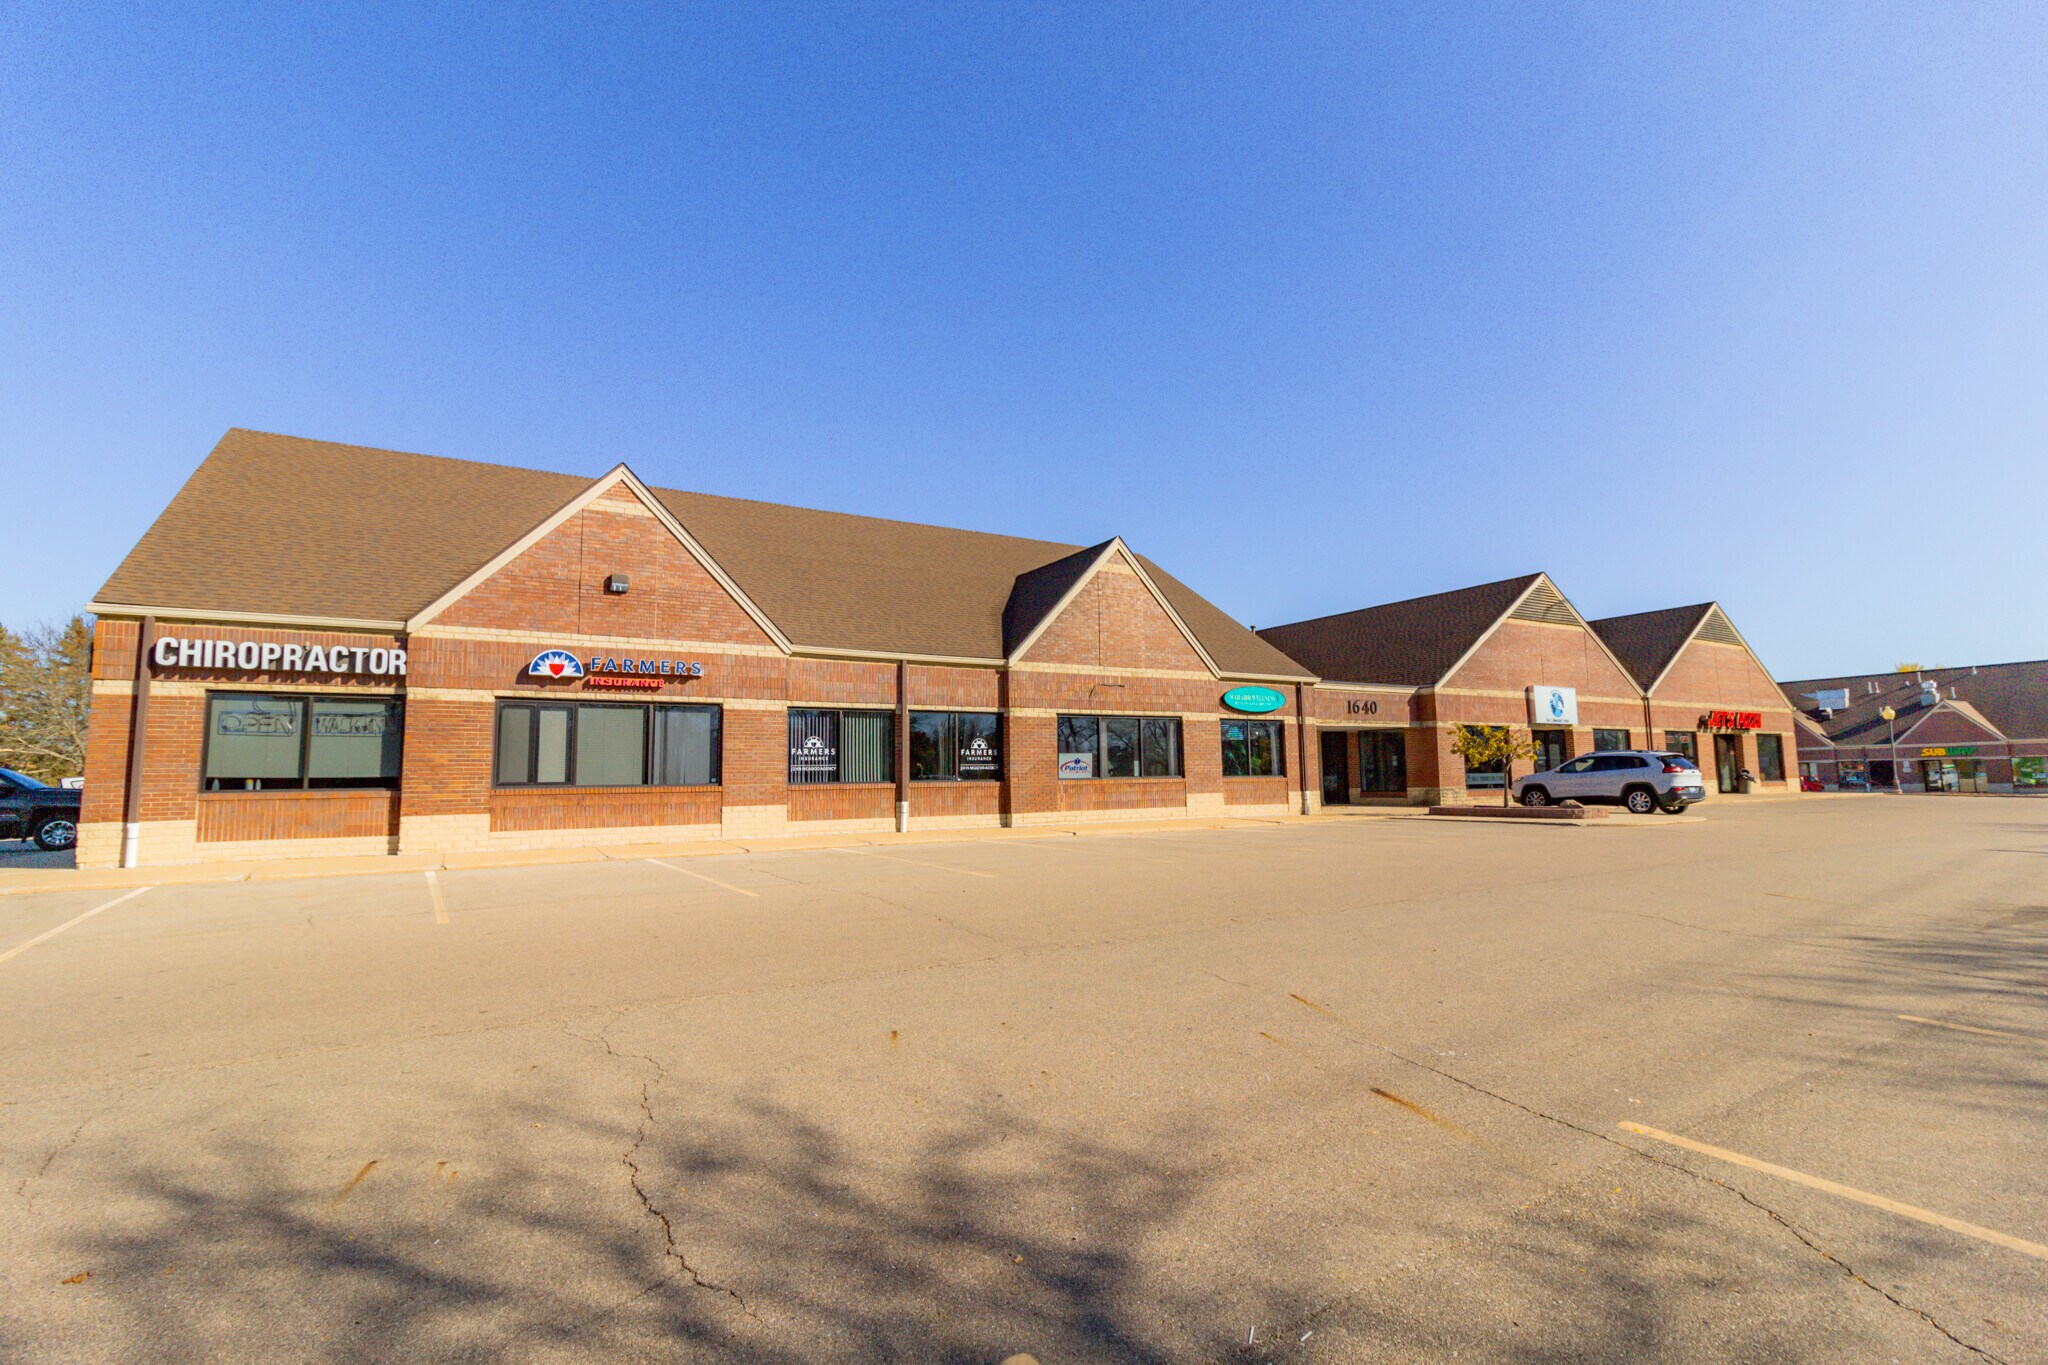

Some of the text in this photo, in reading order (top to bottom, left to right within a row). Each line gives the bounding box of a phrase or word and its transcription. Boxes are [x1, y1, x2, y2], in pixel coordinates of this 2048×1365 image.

[155, 637, 407, 675] CHIROPRACTOR
[591, 657, 702, 675] FARMERS
[590, 676, 664, 687] INSURANCE
[1347, 700, 1377, 714] 1640
[222, 714, 293, 735] OPEN
[1708, 710, 1735, 728] JET'S
[1921, 746, 1977, 757] SUBWAY
